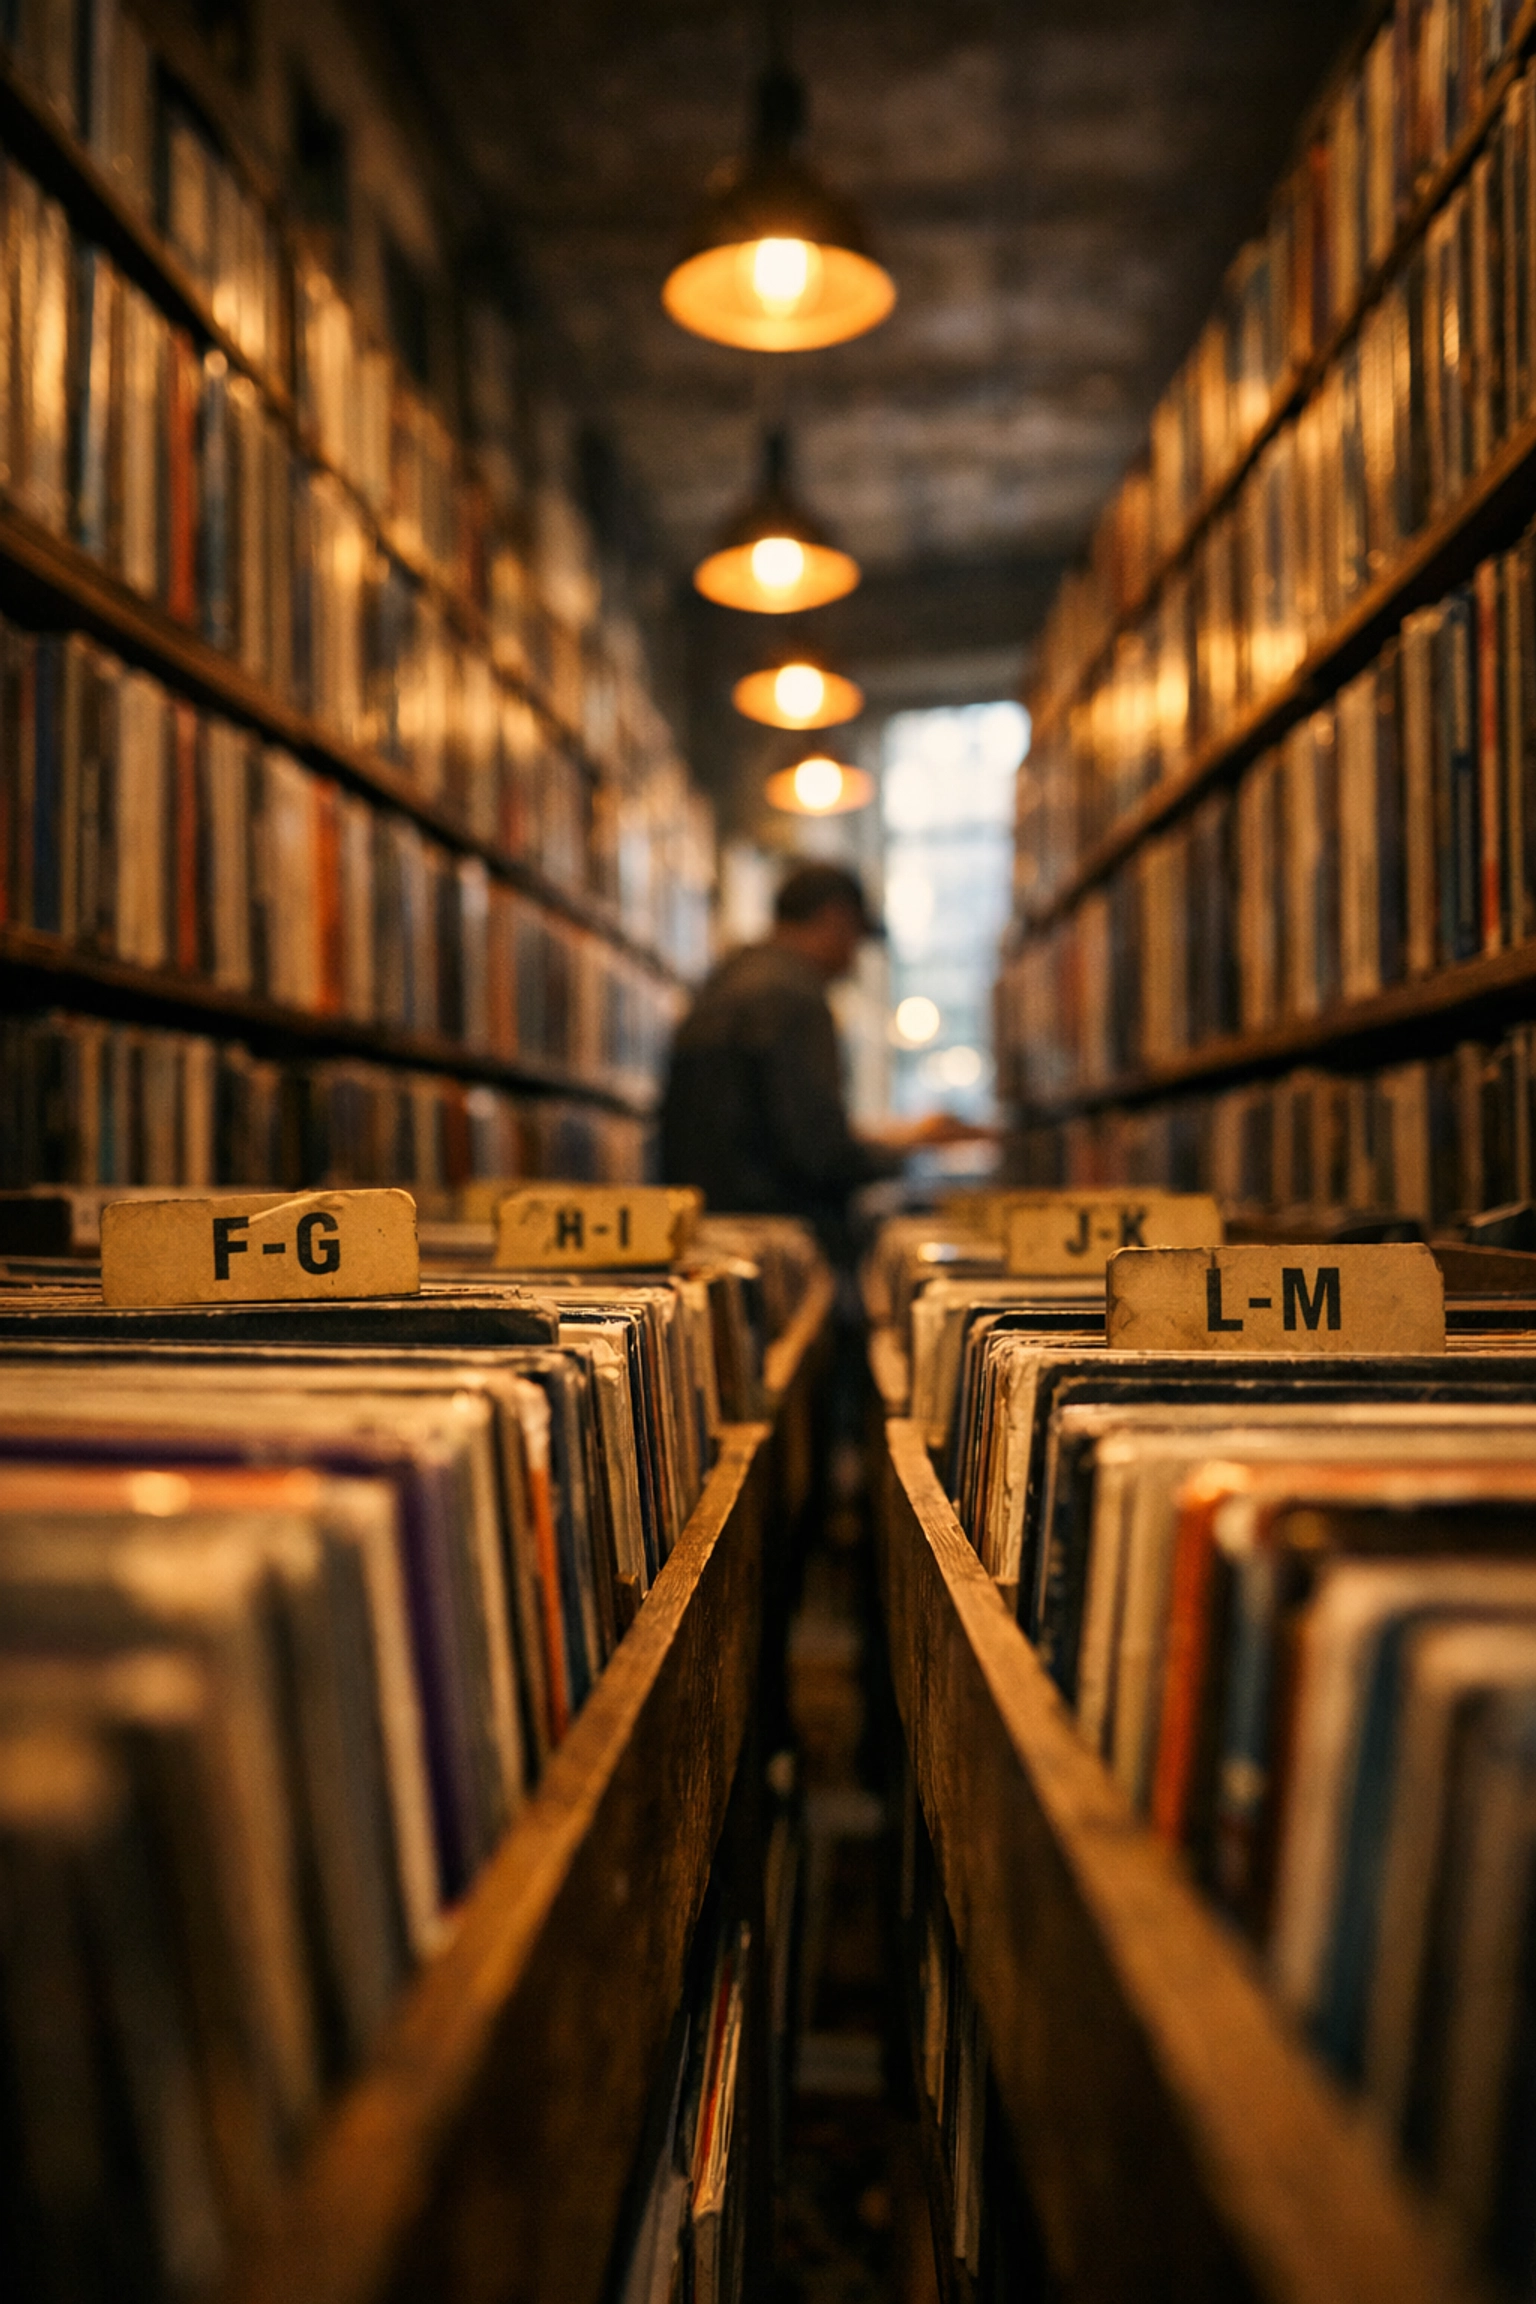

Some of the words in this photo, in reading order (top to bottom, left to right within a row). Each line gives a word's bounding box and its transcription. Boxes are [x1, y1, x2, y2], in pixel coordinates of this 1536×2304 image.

[213, 1212, 340, 1281] F-G
[556, 1207, 630, 1250] H-I
[1065, 1206, 1147, 1257] J-K
[1206, 1267, 1341, 1332] L-M
